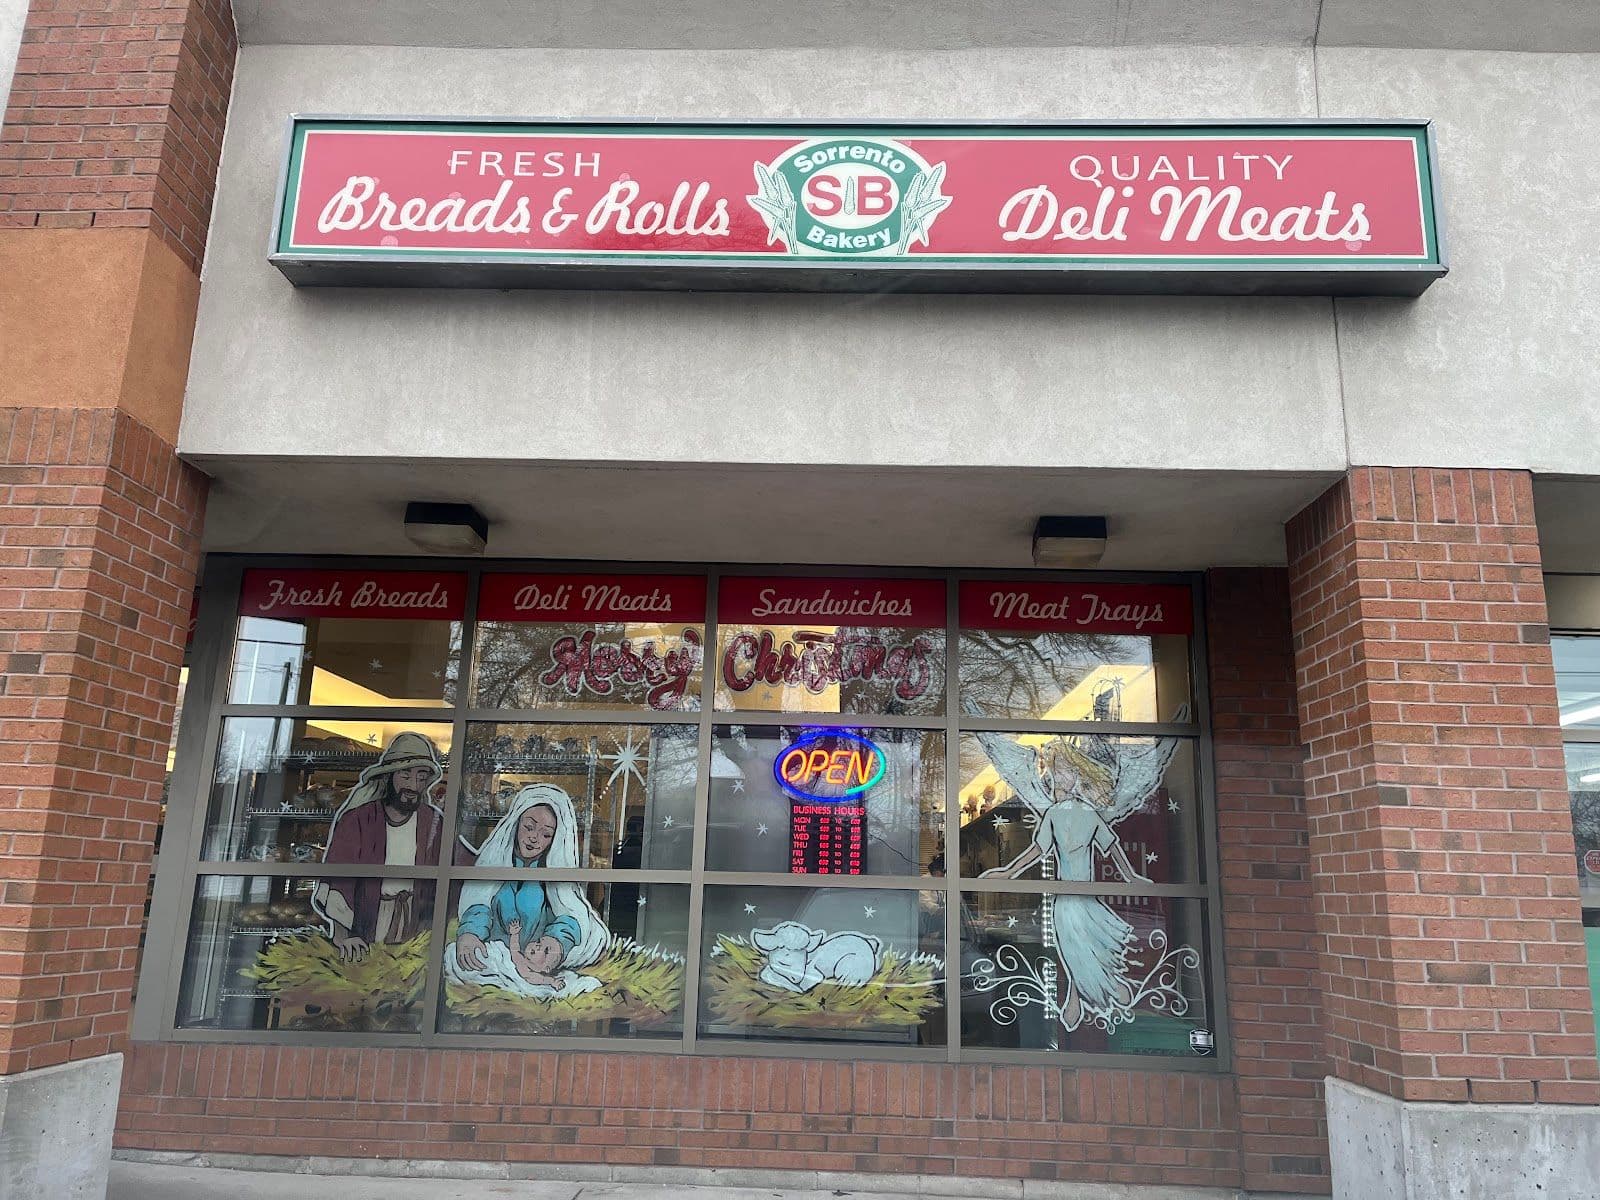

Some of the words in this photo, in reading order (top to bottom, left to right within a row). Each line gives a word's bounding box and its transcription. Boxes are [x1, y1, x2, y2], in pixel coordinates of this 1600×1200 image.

[449, 150, 600, 177] FRESH
[794, 145, 906, 174] Sorrento
[1069, 153, 1293, 187] QUALITY
[317, 175, 531, 234] Breads
[542, 187, 578, 235] &
[585, 177, 730, 236] Rolls
[998, 184, 1132, 242] Deli
[1150, 184, 1372, 242] Meats
[807, 225, 891, 249] Bakery
[258, 580, 341, 611] Fresh
[351, 580, 448, 609] Breads
[514, 584, 574, 611] Deli
[582, 584, 672, 612] Meats
[751, 588, 912, 617] Sandwiches
[990, 591, 1069, 620] Meat
[1076, 594, 1164, 628] Trays
[781, 749, 875, 785] OPEN
[793, 805, 832, 815] BUSINESS
[834, 806, 865, 816] HOURS
[793, 816, 811, 824] MON
[793, 833, 810, 841] WED
[793, 841, 808, 849] THU
[792, 849, 804, 857] FRI
[791, 866, 807, 874] SUN
